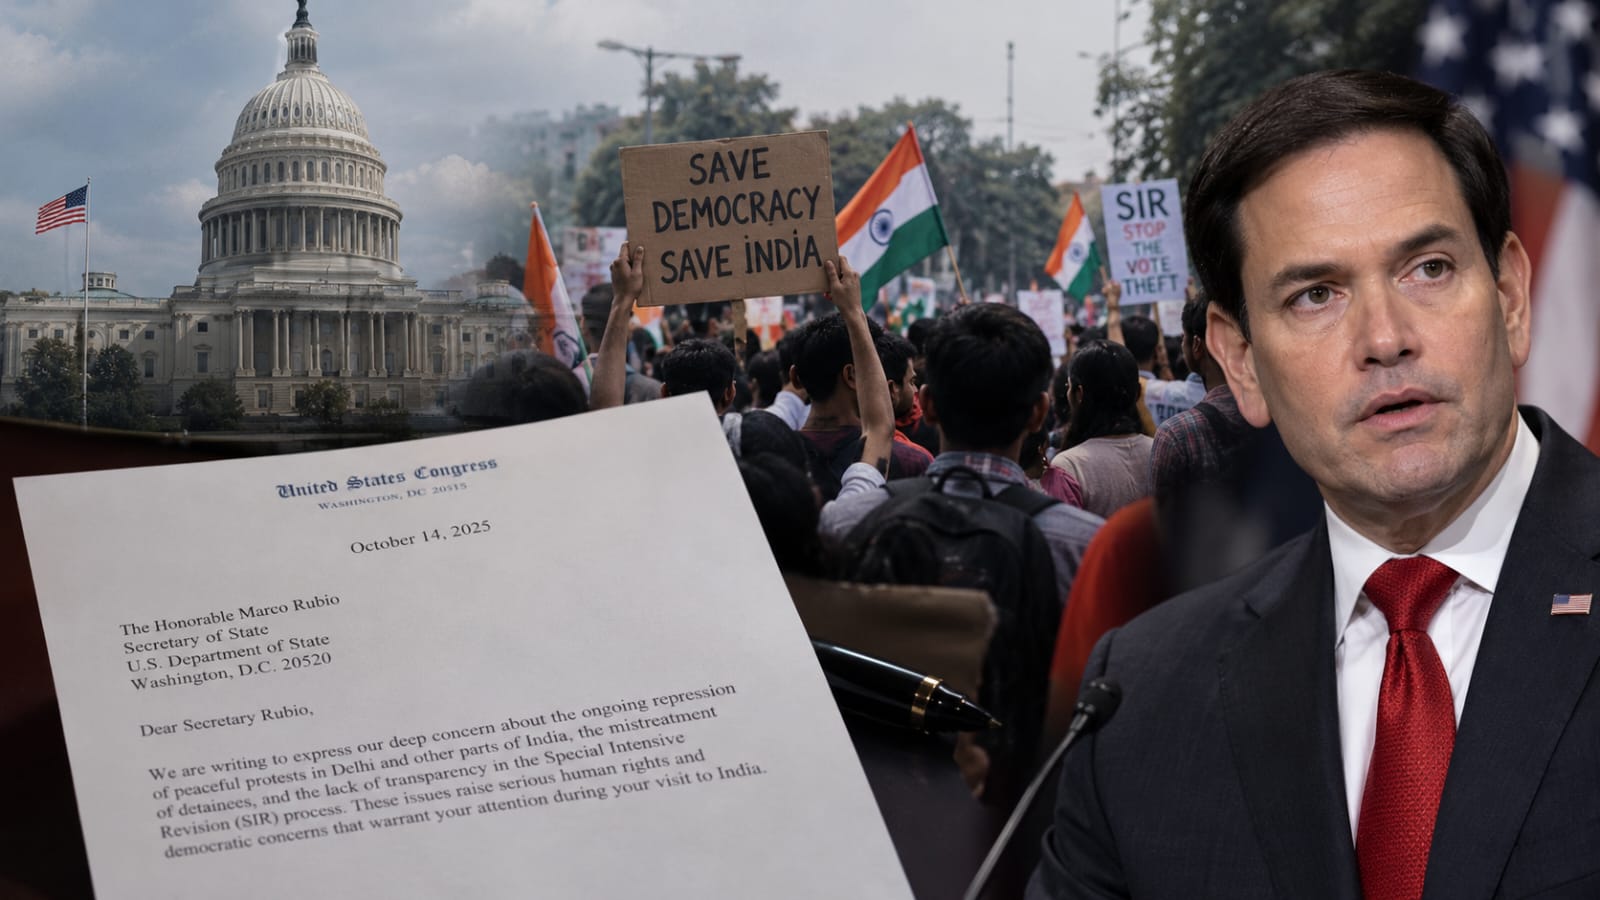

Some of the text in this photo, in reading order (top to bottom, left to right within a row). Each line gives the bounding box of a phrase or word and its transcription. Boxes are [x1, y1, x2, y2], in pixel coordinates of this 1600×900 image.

[690, 147, 770, 187] SAVE
[652, 185, 821, 234] DEMOCRACY
[1116, 188, 1169, 220] SIR
[1122, 222, 1167, 241] STOP
[1132, 240, 1163, 255] THE
[660, 244, 734, 285] SAVE
[1126, 256, 1171, 274] VOTE
[1121, 274, 1179, 296] THEFT
[275, 458, 498, 499] United States Congress
[406, 488, 426, 498] DC
[350, 519, 491, 554] October 14, 2025
[119, 593, 340, 636] The Honorable Marco Rubio
[123, 625, 270, 655] Secretary of State
[126, 635, 331, 673] U.S. Department of State
[130, 651, 332, 691] Washington, D.C. 20520
[139, 704, 314, 737] Dear Secretary Rubio,
[148, 684, 737, 781] We are writing to express our deep concern about the ongoing repression
[152, 706, 718, 801] of peaceful protests in Delhi and other parts of India, the mistreatment
[156, 733, 686, 820] of detainees, and the lack of transparency in the Special Intensive
[160, 748, 706, 839] Revision (SIR) process. These issues raise serious human rights and
[164, 762, 767, 859] democratic concerns that warrant your attention during your visit to India.
